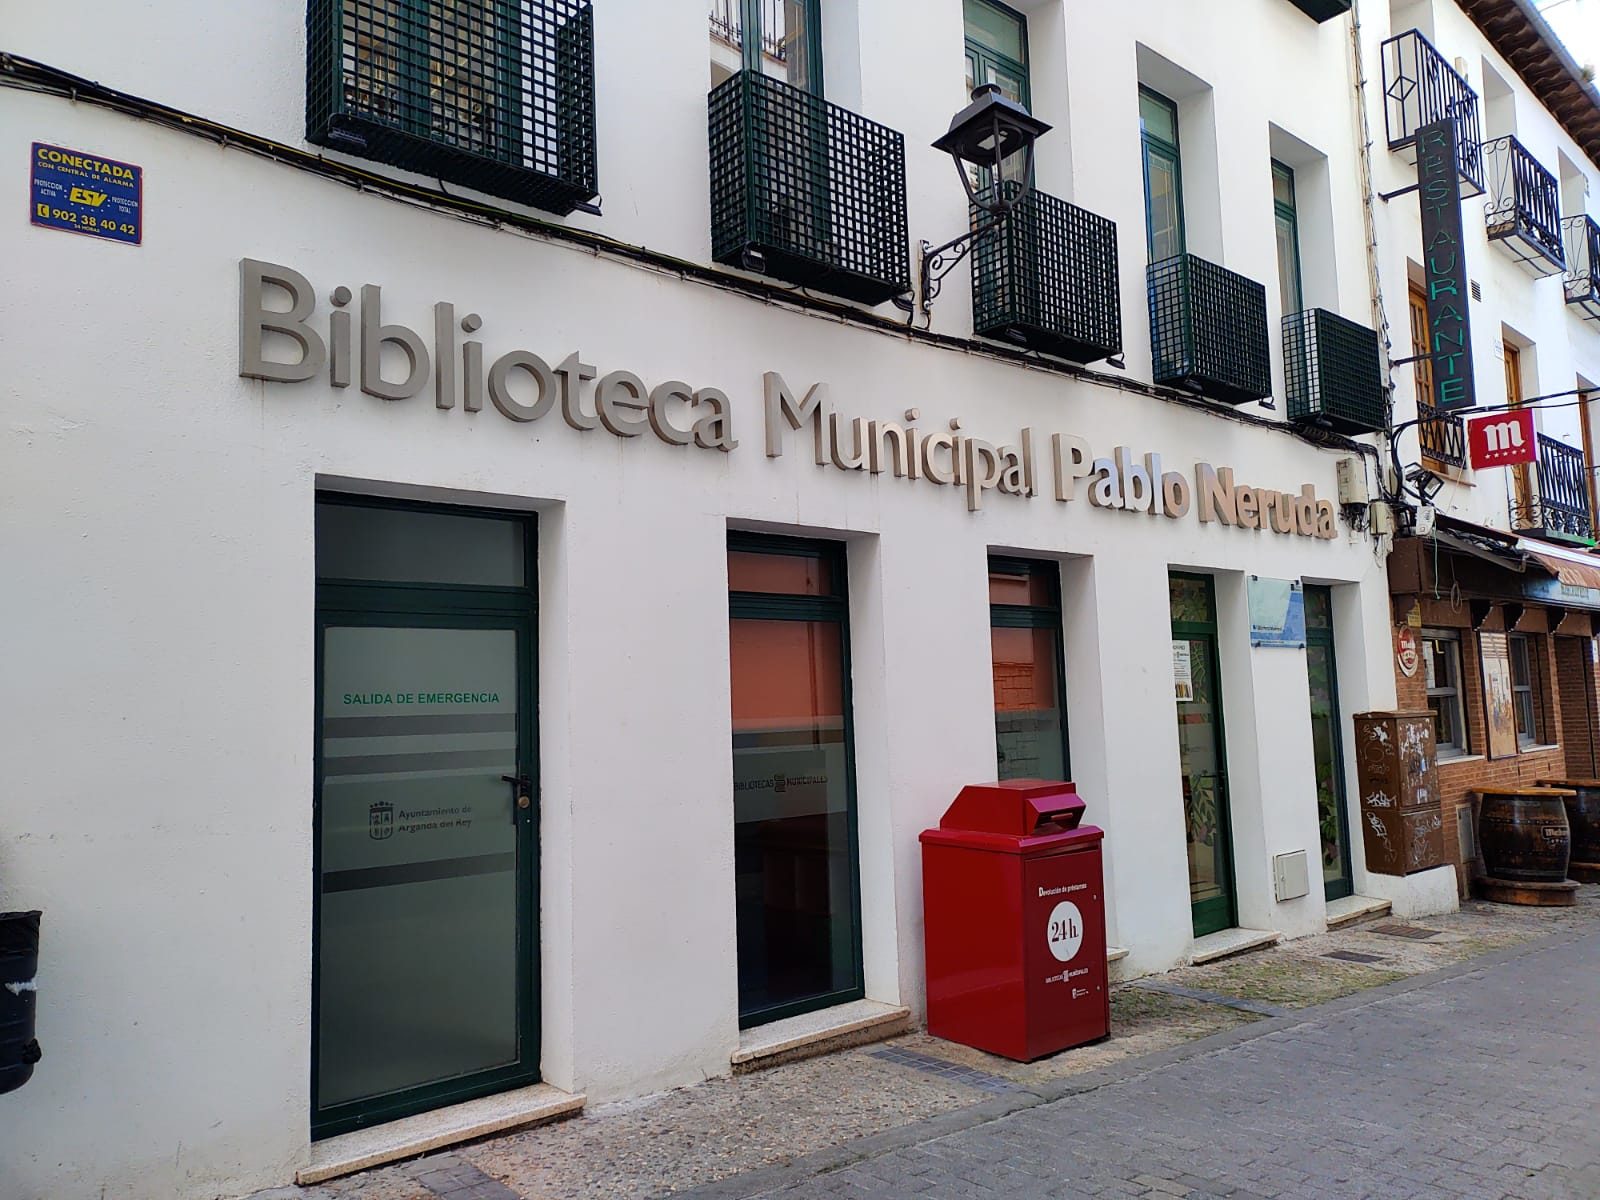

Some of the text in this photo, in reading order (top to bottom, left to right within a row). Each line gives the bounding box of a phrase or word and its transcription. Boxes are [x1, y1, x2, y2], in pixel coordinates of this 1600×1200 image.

[38, 148, 134, 180] CONECTADA
[38, 161, 54, 170] CON
[57, 166, 88, 178] CENTRAL
[103, 176, 134, 188] ALARMA
[70, 187, 108, 207] ESV
[52, 208, 135, 235] 902 38 40 42
[1421, 130, 1465, 404] RESTAURANTE
[239, 257, 1338, 539] Biblioteca Municipal Pablo Neruda
[343, 692, 500, 705] SALIDA DE EMERGENCIA
[398, 807, 460, 820] Ayuntamiento
[398, 821, 438, 834] Arganda
[1052, 918, 1079, 943] 24h
